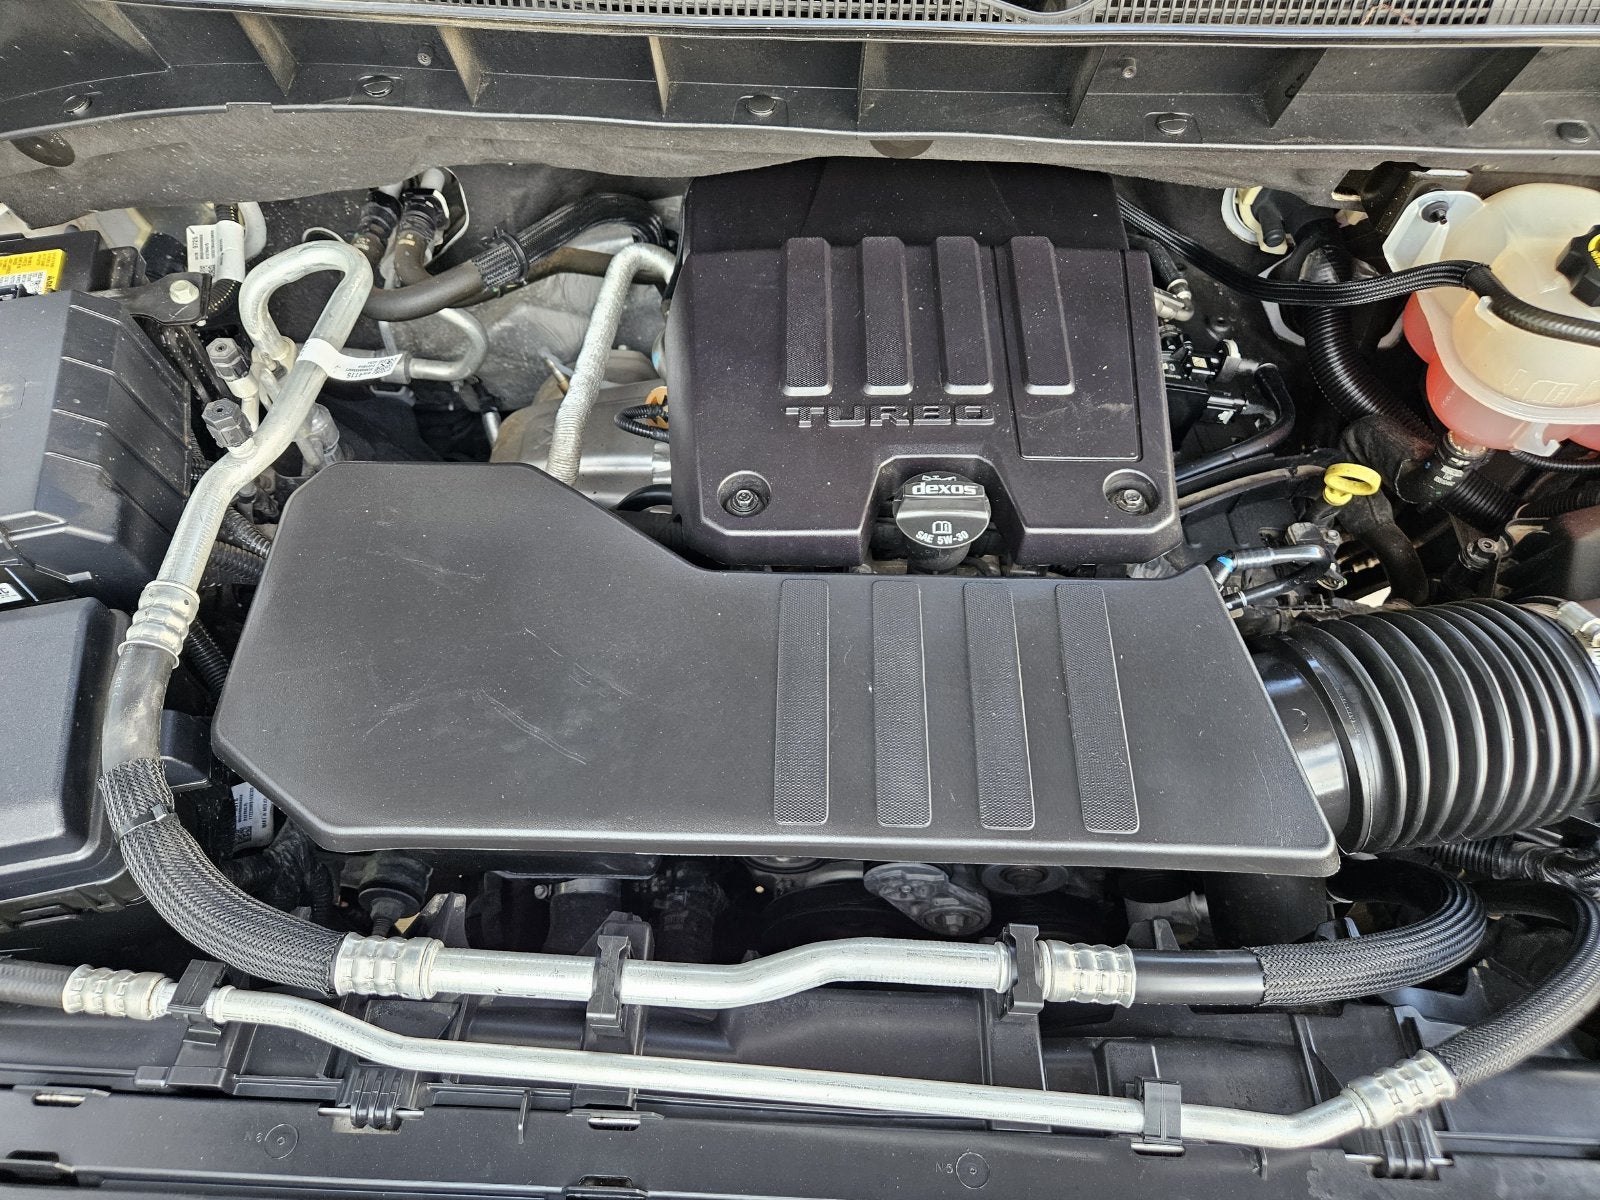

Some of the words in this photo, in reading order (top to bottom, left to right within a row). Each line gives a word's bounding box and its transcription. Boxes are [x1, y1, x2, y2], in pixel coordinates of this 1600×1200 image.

[785, 405, 995, 428] TURBO
[911, 482, 978, 495] dexos
[915, 530, 934, 543] SAE
[936, 530, 969, 545] 5W-30
